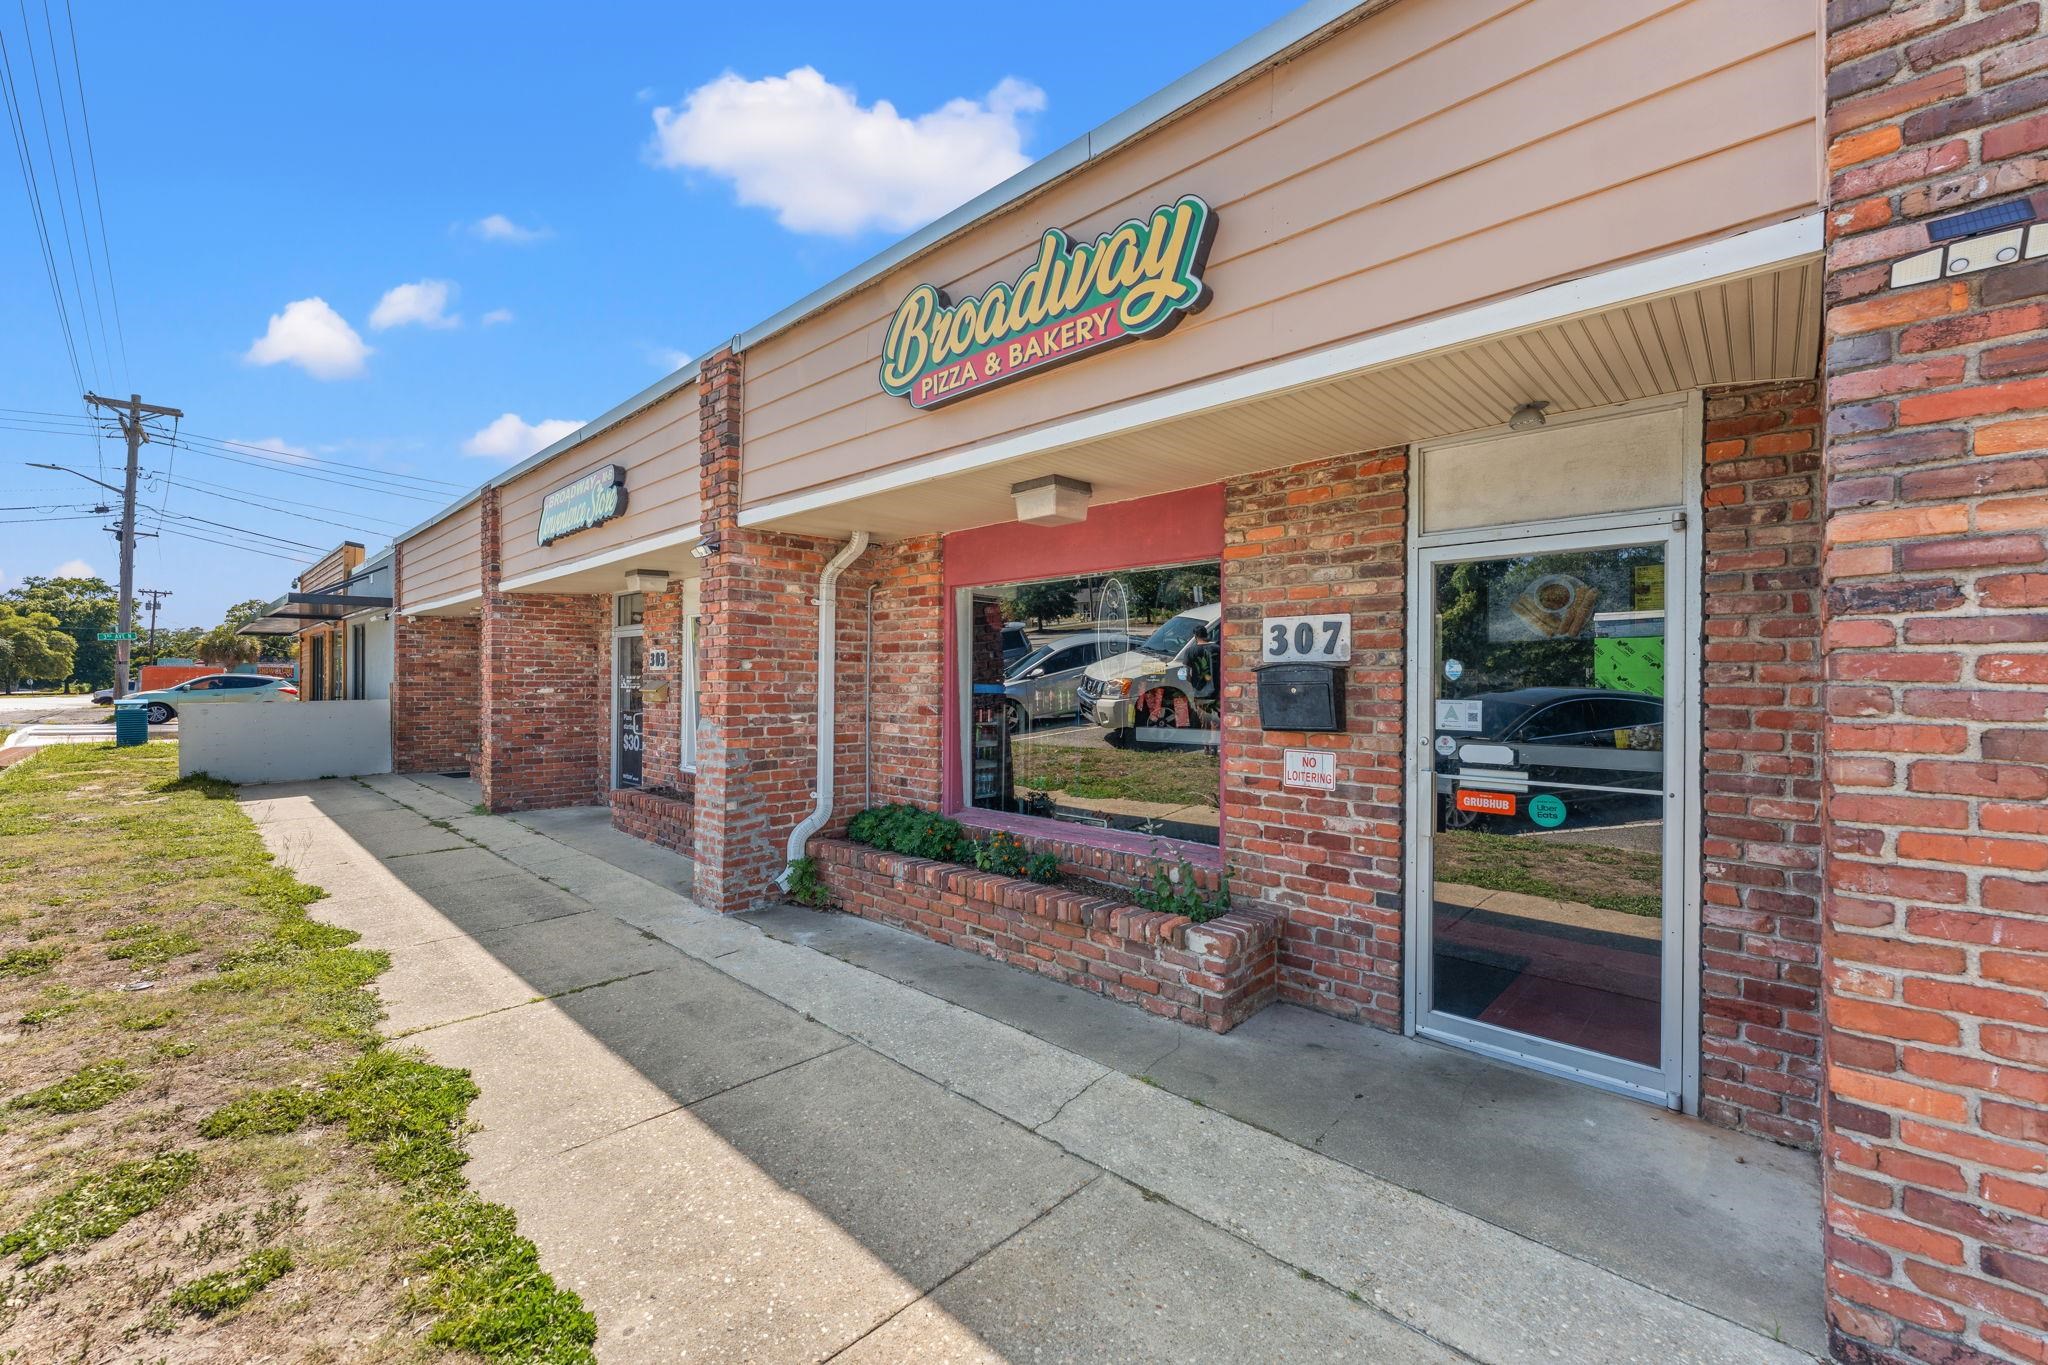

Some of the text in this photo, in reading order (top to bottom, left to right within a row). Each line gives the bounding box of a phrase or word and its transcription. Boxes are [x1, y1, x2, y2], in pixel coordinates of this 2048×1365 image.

[884, 204, 1193, 387] Broadway
[921, 308, 1114, 400] PIZZA & BAKERY
[548, 474, 597, 507] BROADWAY
[586, 480, 617, 528] Store
[1269, 621, 1342, 656] 307
[649, 652, 666, 667] 303
[623, 732, 640, 751] $30
[1302, 756, 1317, 768] NO
[1287, 770, 1332, 785] LOITERING
[1463, 796, 1510, 810] GRUBHUB
[1537, 804, 1558, 812] Uber
[1537, 811, 1558, 819] Eats
